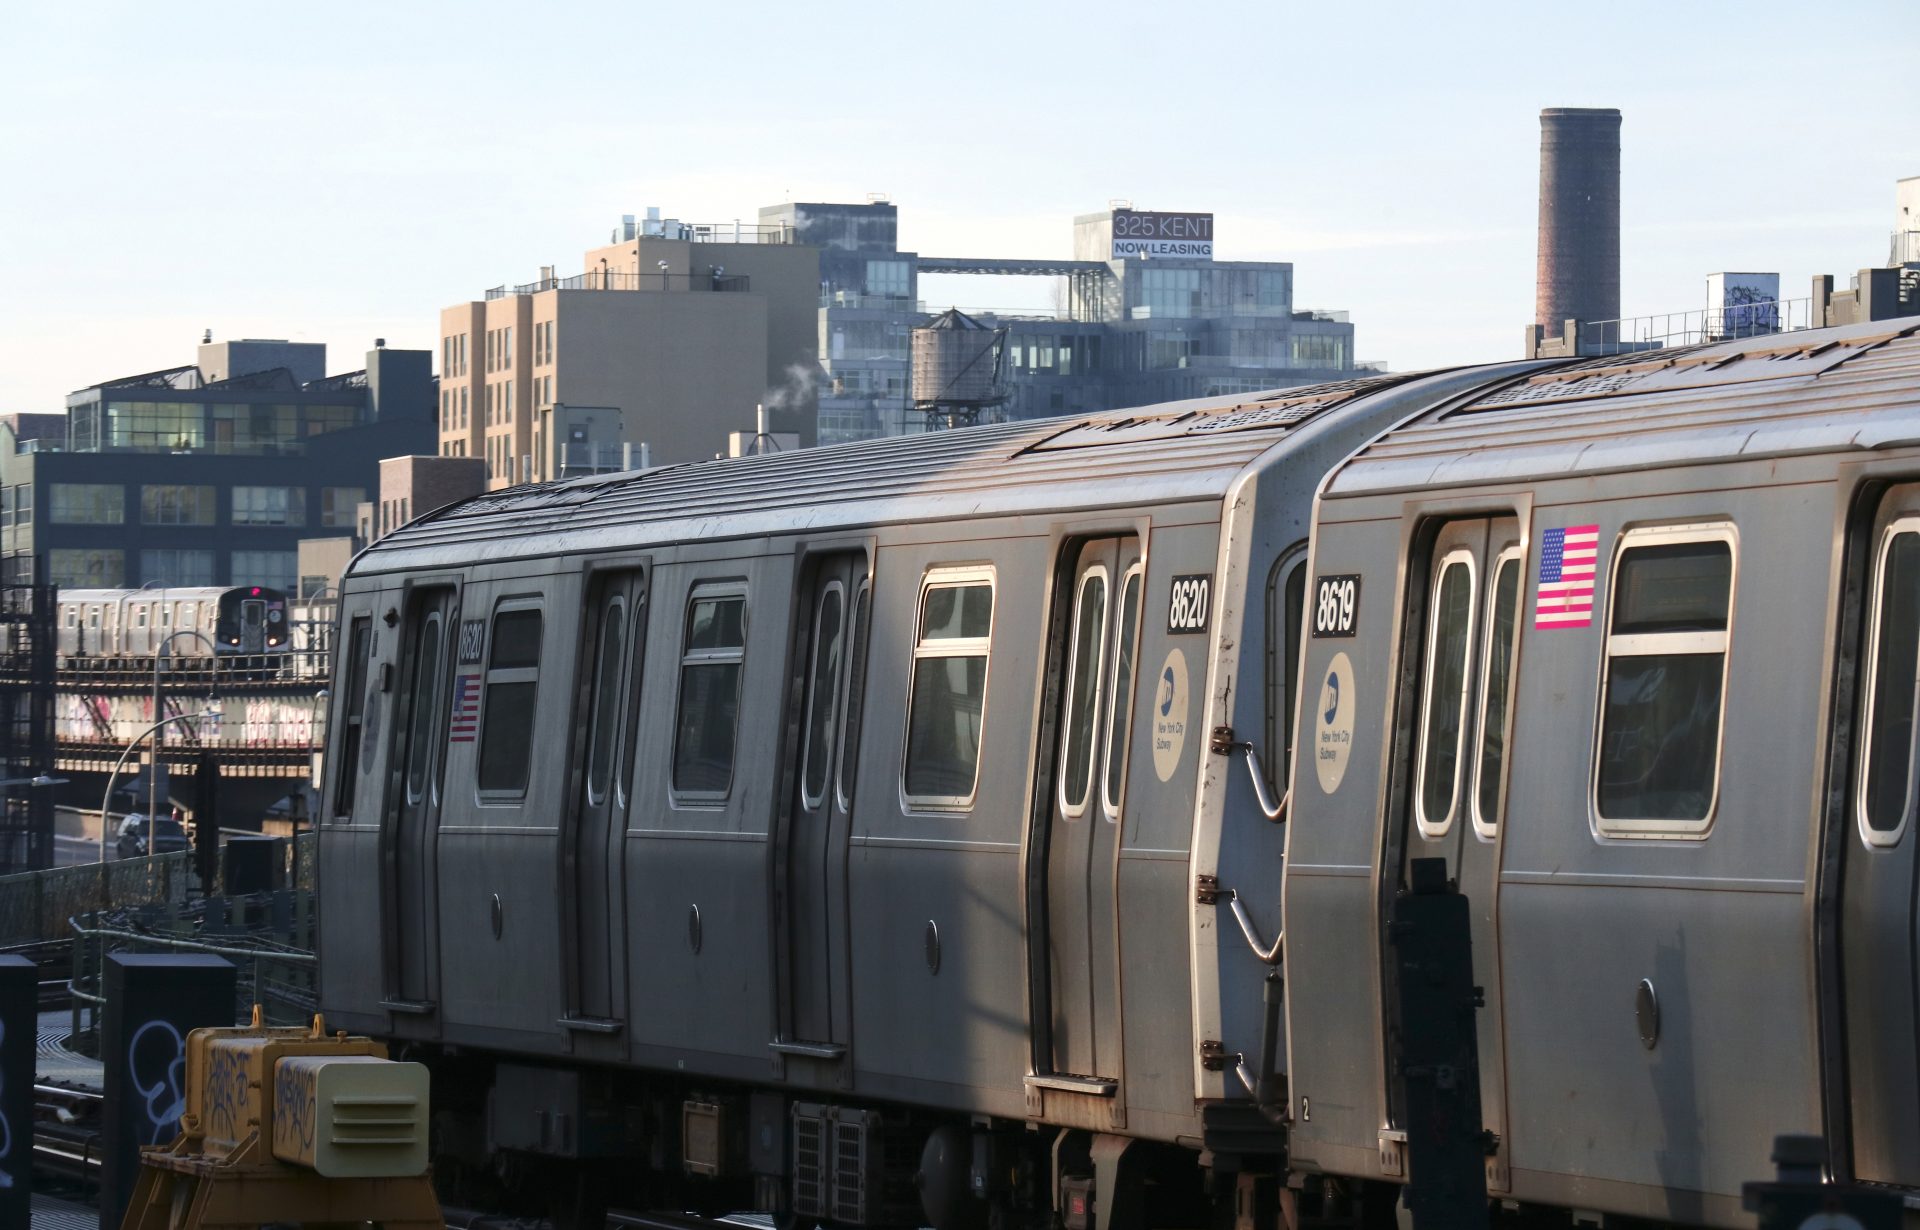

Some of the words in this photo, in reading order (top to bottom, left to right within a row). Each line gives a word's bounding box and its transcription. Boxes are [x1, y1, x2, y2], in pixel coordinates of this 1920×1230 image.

[1115, 216, 1154, 236] 325
[1160, 217, 1212, 237] KENT
[1115, 242, 1149, 254] NOW
[1151, 243, 1211, 255] LEASING
[1169, 579, 1208, 629] 8620
[1316, 580, 1355, 632] 8619
[461, 623, 483, 660] 8620
[1158, 722, 1167, 734] New
[1167, 721, 1176, 734] York
[1175, 722, 1184, 736] City
[1321, 730, 1331, 742] New
[1331, 730, 1341, 742] York
[1341, 730, 1350, 744] City
[1157, 738, 1171, 752] Subway
[1319, 747, 1336, 762] Subway
[1303, 1098, 1309, 1120] 2
